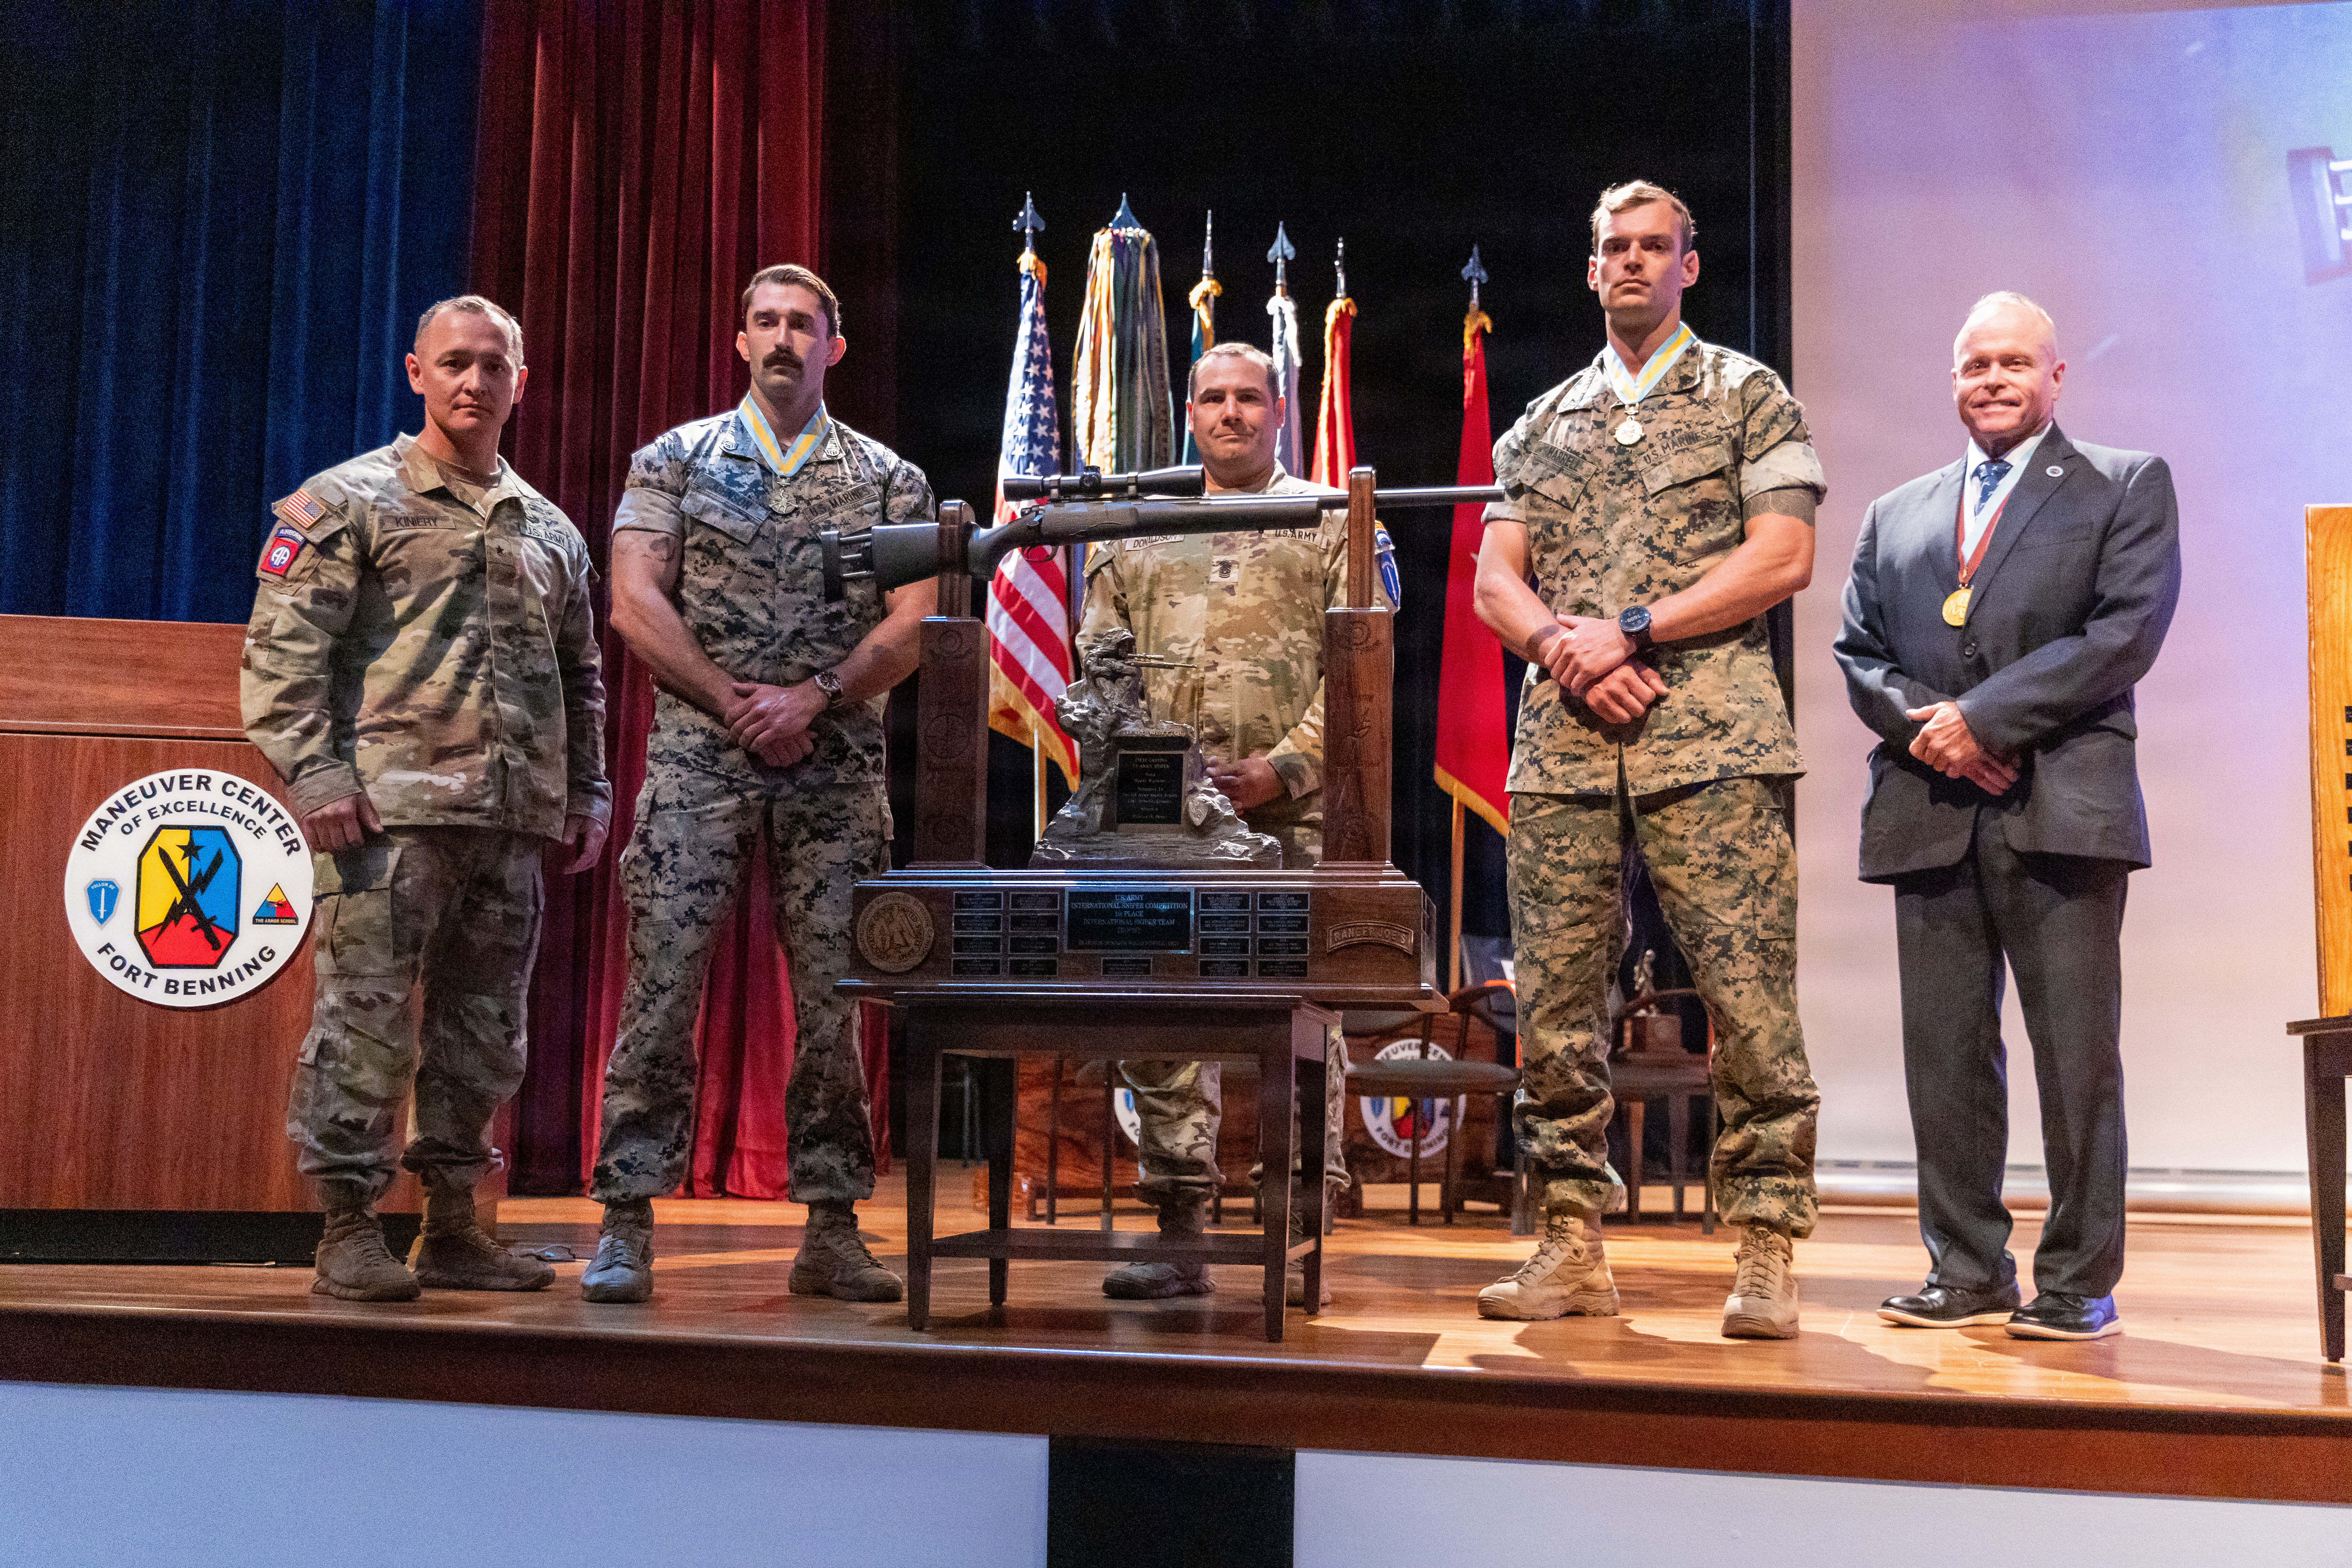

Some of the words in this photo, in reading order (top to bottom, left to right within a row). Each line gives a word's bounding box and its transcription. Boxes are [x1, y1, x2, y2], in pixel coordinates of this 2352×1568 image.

[1661, 430, 1707, 454] MARINES
[1547, 447, 1579, 472] HARRELL
[828, 486, 870, 509] MARINES
[544, 531, 565, 547] ARMY
[1133, 535, 1176, 548] DONALDSON
[1291, 530, 1317, 542] ARMY
[81, 775, 212, 852] MANEUVER
[221, 780, 301, 857] CENTER
[121, 815, 143, 836] OF
[147, 800, 267, 840] EXCELLENCE
[1334, 927, 1374, 942] RANGER
[97, 942, 158, 989] FORT
[164, 946, 276, 996] BENNING
